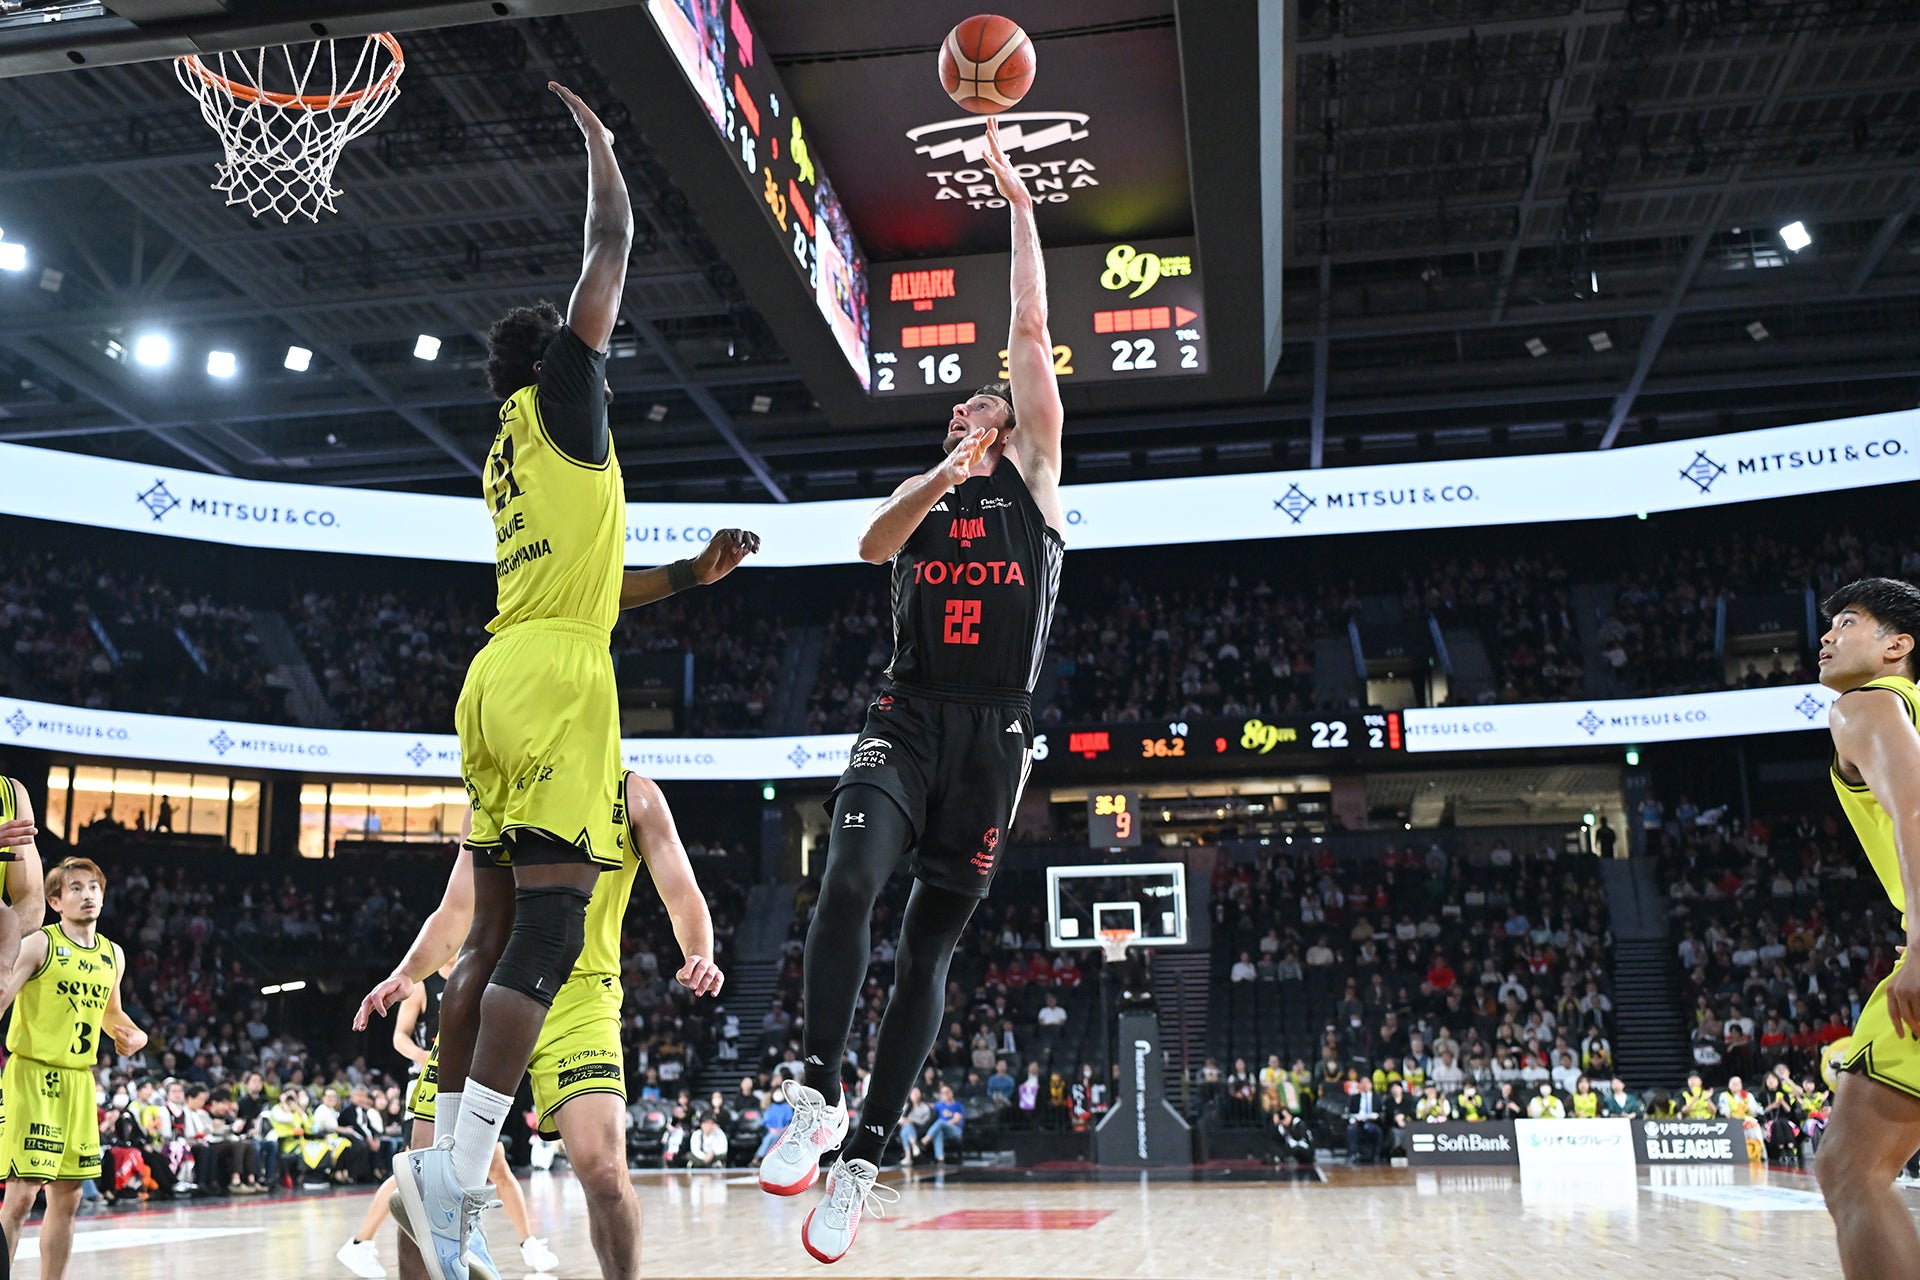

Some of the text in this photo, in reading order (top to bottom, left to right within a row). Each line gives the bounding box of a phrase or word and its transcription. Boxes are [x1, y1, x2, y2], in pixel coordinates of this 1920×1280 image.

[926, 158, 1096, 185] TOOTA
[935, 174, 1100, 200] ARNA
[966, 192, 1069, 210] TOYO
[890, 269, 956, 301] ALVARK
[1110, 338, 1157, 371] 22
[1180, 345, 1198, 368] 2
[877, 367, 895, 391] 2
[918, 353, 962, 385] 16
[913, 561, 1025, 586] TOYOTA
[943, 599, 982, 645] 22
[1215, 737, 1227, 752] 9
[1310, 721, 1348, 748] 22
[1369, 728, 1384, 748] 2
[1142, 738, 1185, 758] 36.2
[1116, 812, 1131, 838] 9
[56, 980, 110, 1000] seven
[70, 1022, 92, 1054] 3
[568, 1049, 619, 1064] バイタルネット
[1659, 1122, 1729, 1136] りそなグループ
[1437, 1134, 1511, 1152] SoftBank
[1646, 1138, 1734, 1160] B.LEAGUE
[41, 1158, 57, 1168] JAL
